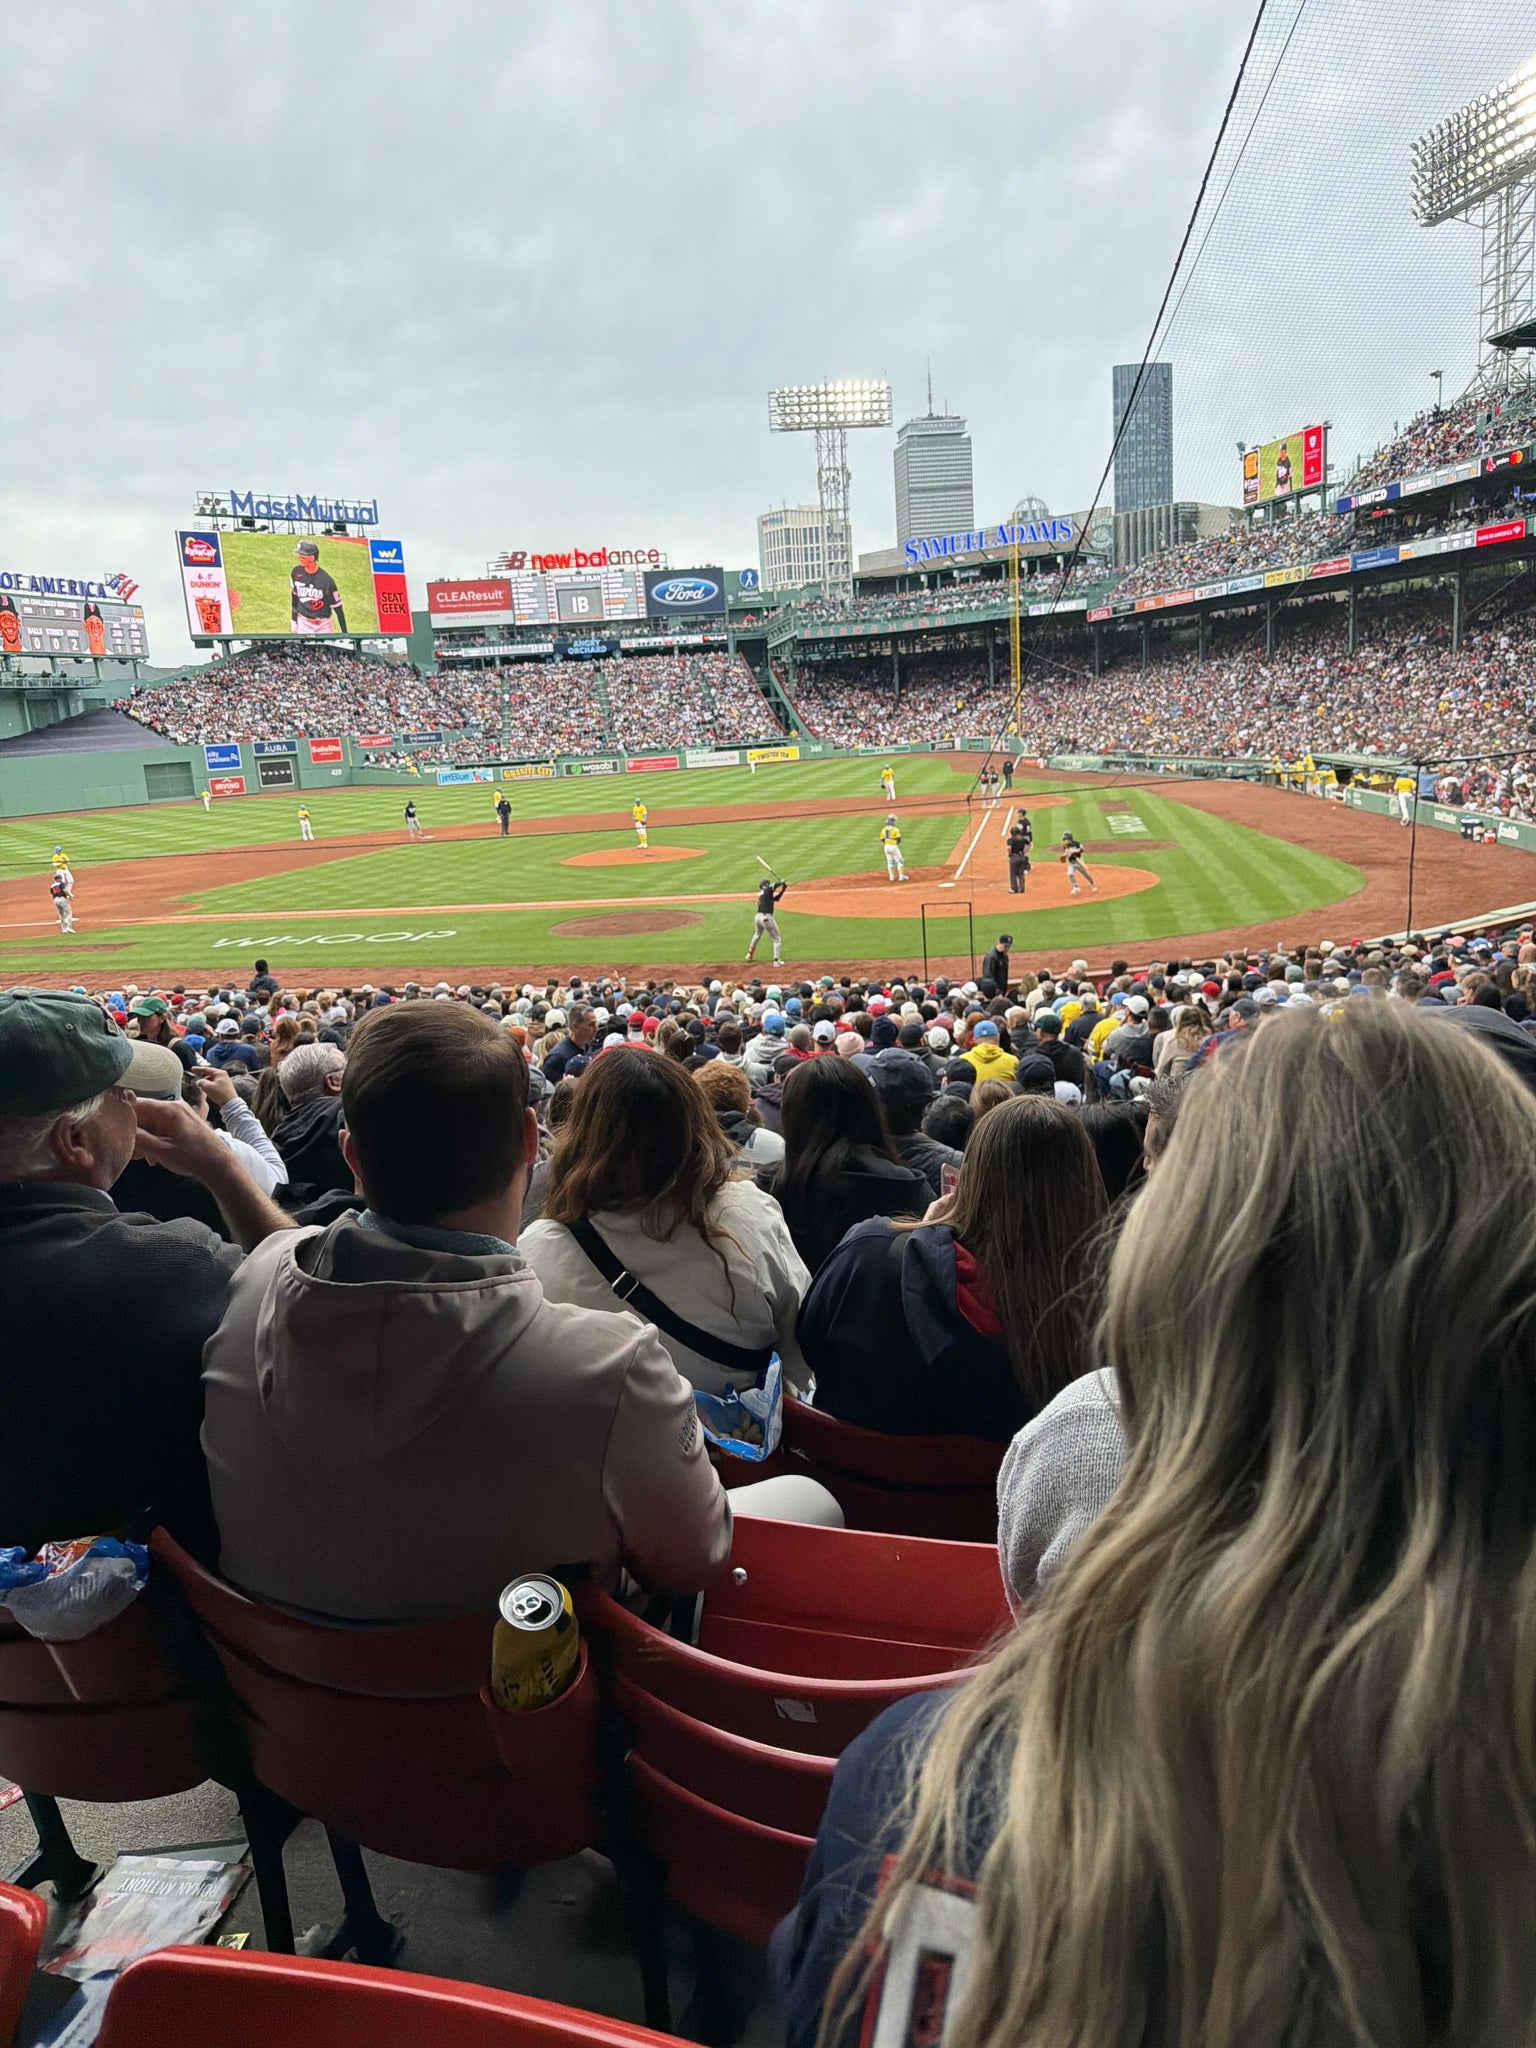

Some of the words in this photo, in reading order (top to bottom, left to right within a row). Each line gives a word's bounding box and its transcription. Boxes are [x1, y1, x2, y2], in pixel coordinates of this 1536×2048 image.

[1359, 489, 1388, 506] UNITED
[230, 490, 379, 525] MassMutual
[904, 530, 986, 566] SAMUEL
[991, 517, 1074, 547] ADAMS
[531, 553, 572, 571] new
[574, 547, 660, 568] balance
[0, 572, 23, 590] OF
[29, 575, 108, 599] AMERICA
[294, 581, 324, 600] Twins
[664, 583, 705, 601] Ford
[381, 592, 404, 603] SEAT
[436, 590, 503, 602] CLEAResult
[381, 603, 406, 614] GEEK
[34, 637, 41, 650] 0
[52, 638, 60, 650] 0
[71, 639, 79, 651] 2
[567, 645, 608, 655] ORCHARD
[573, 639, 600, 649] ANGRY
[207, 751, 220, 759] city
[757, 751, 779, 760] TWISTED
[503, 767, 535, 779] GRANITE
[537, 766, 554, 777] CITY
[582, 761, 613, 772] wasabi
[440, 771, 470, 784] jetBlue
[212, 930, 458, 949] WHOOP
[116, 1877, 175, 1896] ANTHONY
[175, 1881, 222, 1897] ROMAN
